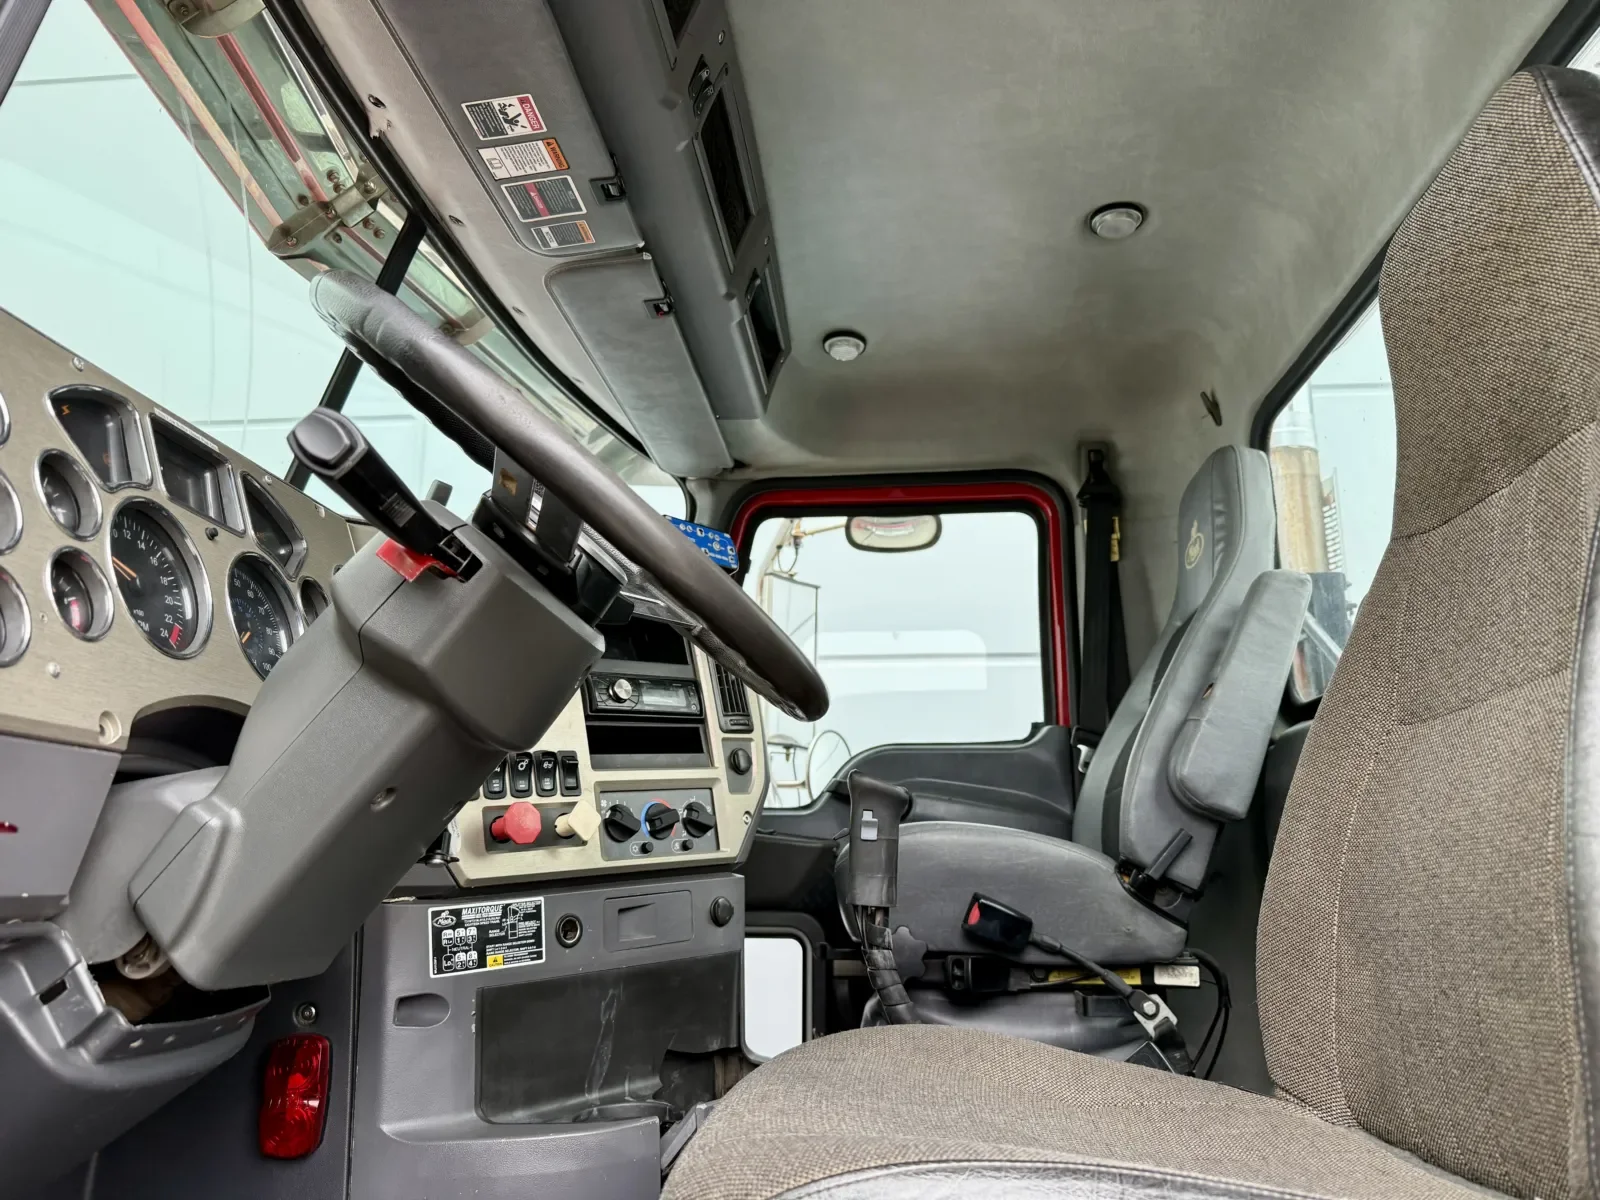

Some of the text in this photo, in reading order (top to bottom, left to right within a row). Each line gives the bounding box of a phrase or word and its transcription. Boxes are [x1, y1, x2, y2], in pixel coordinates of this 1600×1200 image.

[523, 103, 540, 130] DANGER
[550, 146, 565, 168] WARNING
[123, 529, 132, 539] 12
[137, 540, 146, 550] 14
[150, 556, 158, 566] 16
[160, 576, 168, 586] 18
[234, 579, 241, 587] 50
[165, 595, 174, 605] 20
[258, 606, 264, 615] 70
[164, 614, 173, 624] 22
[160, 628, 169, 638] 24
[263, 662, 272, 671] 100
[462, 905, 503, 915] MAXITORQUE
